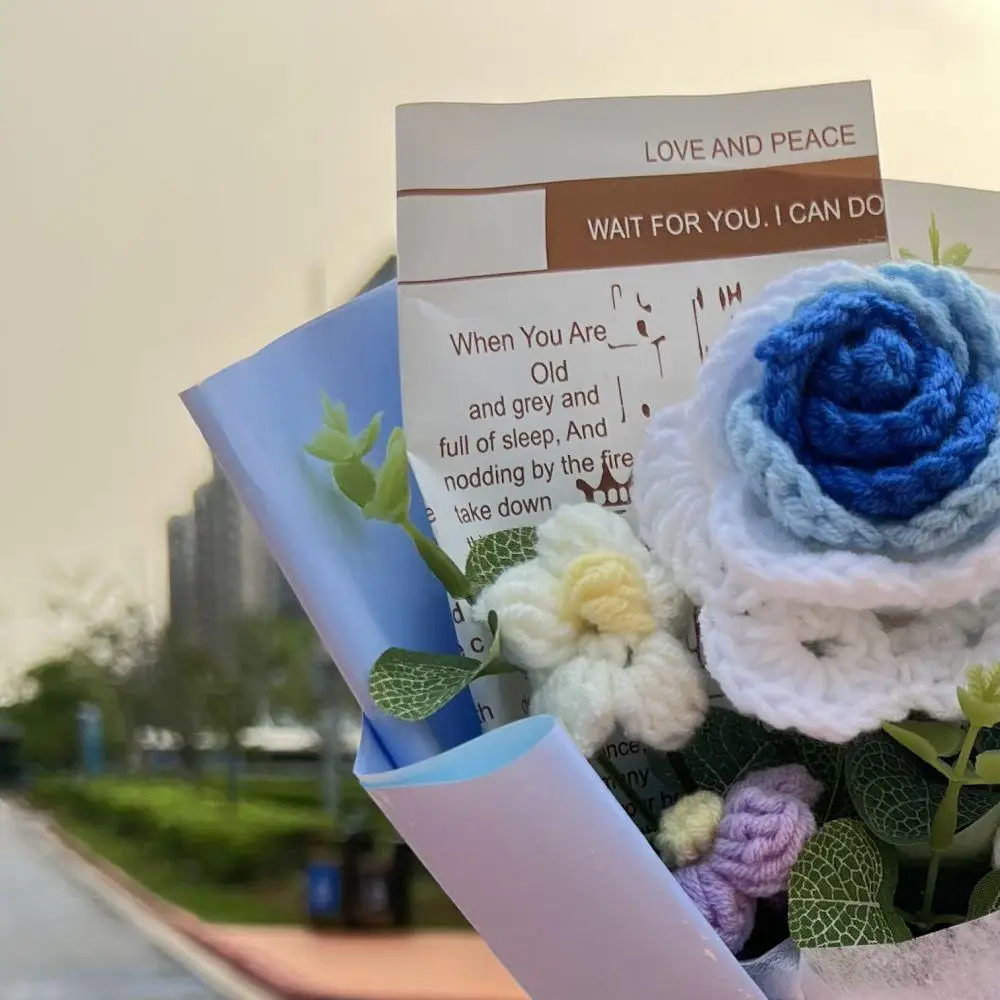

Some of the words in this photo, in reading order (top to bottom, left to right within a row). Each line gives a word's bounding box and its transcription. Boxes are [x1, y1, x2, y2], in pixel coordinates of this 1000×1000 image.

[644, 138, 706, 163] LOVE
[711, 134, 763, 159] AND
[770, 123, 857, 153] PEACE
[587, 215, 644, 241] WAIT
[650, 211, 703, 237] FOR
[706, 204, 769, 232] YOU.
[774, 203, 782, 226] I
[788, 196, 842, 225] CAN
[848, 194, 885, 219] DO
[449, 331, 515, 356] When
[520, 324, 563, 348] You
[568, 321, 607, 345] Are
[530, 359, 569, 385] Old
[468, 395, 506, 420] and
[512, 392, 555, 420] grey
[561, 384, 600, 409] and
[439, 434, 470, 458] full
[476, 430, 496, 454] of
[502, 427, 561, 450] sleep,
[566, 417, 609, 442] And
[443, 463, 526, 492] nodding
[531, 459, 555, 483] by
[560, 453, 595, 476] the
[600, 449, 634, 471] fire
[454, 501, 492, 525] take
[497, 494, 553, 518] down
